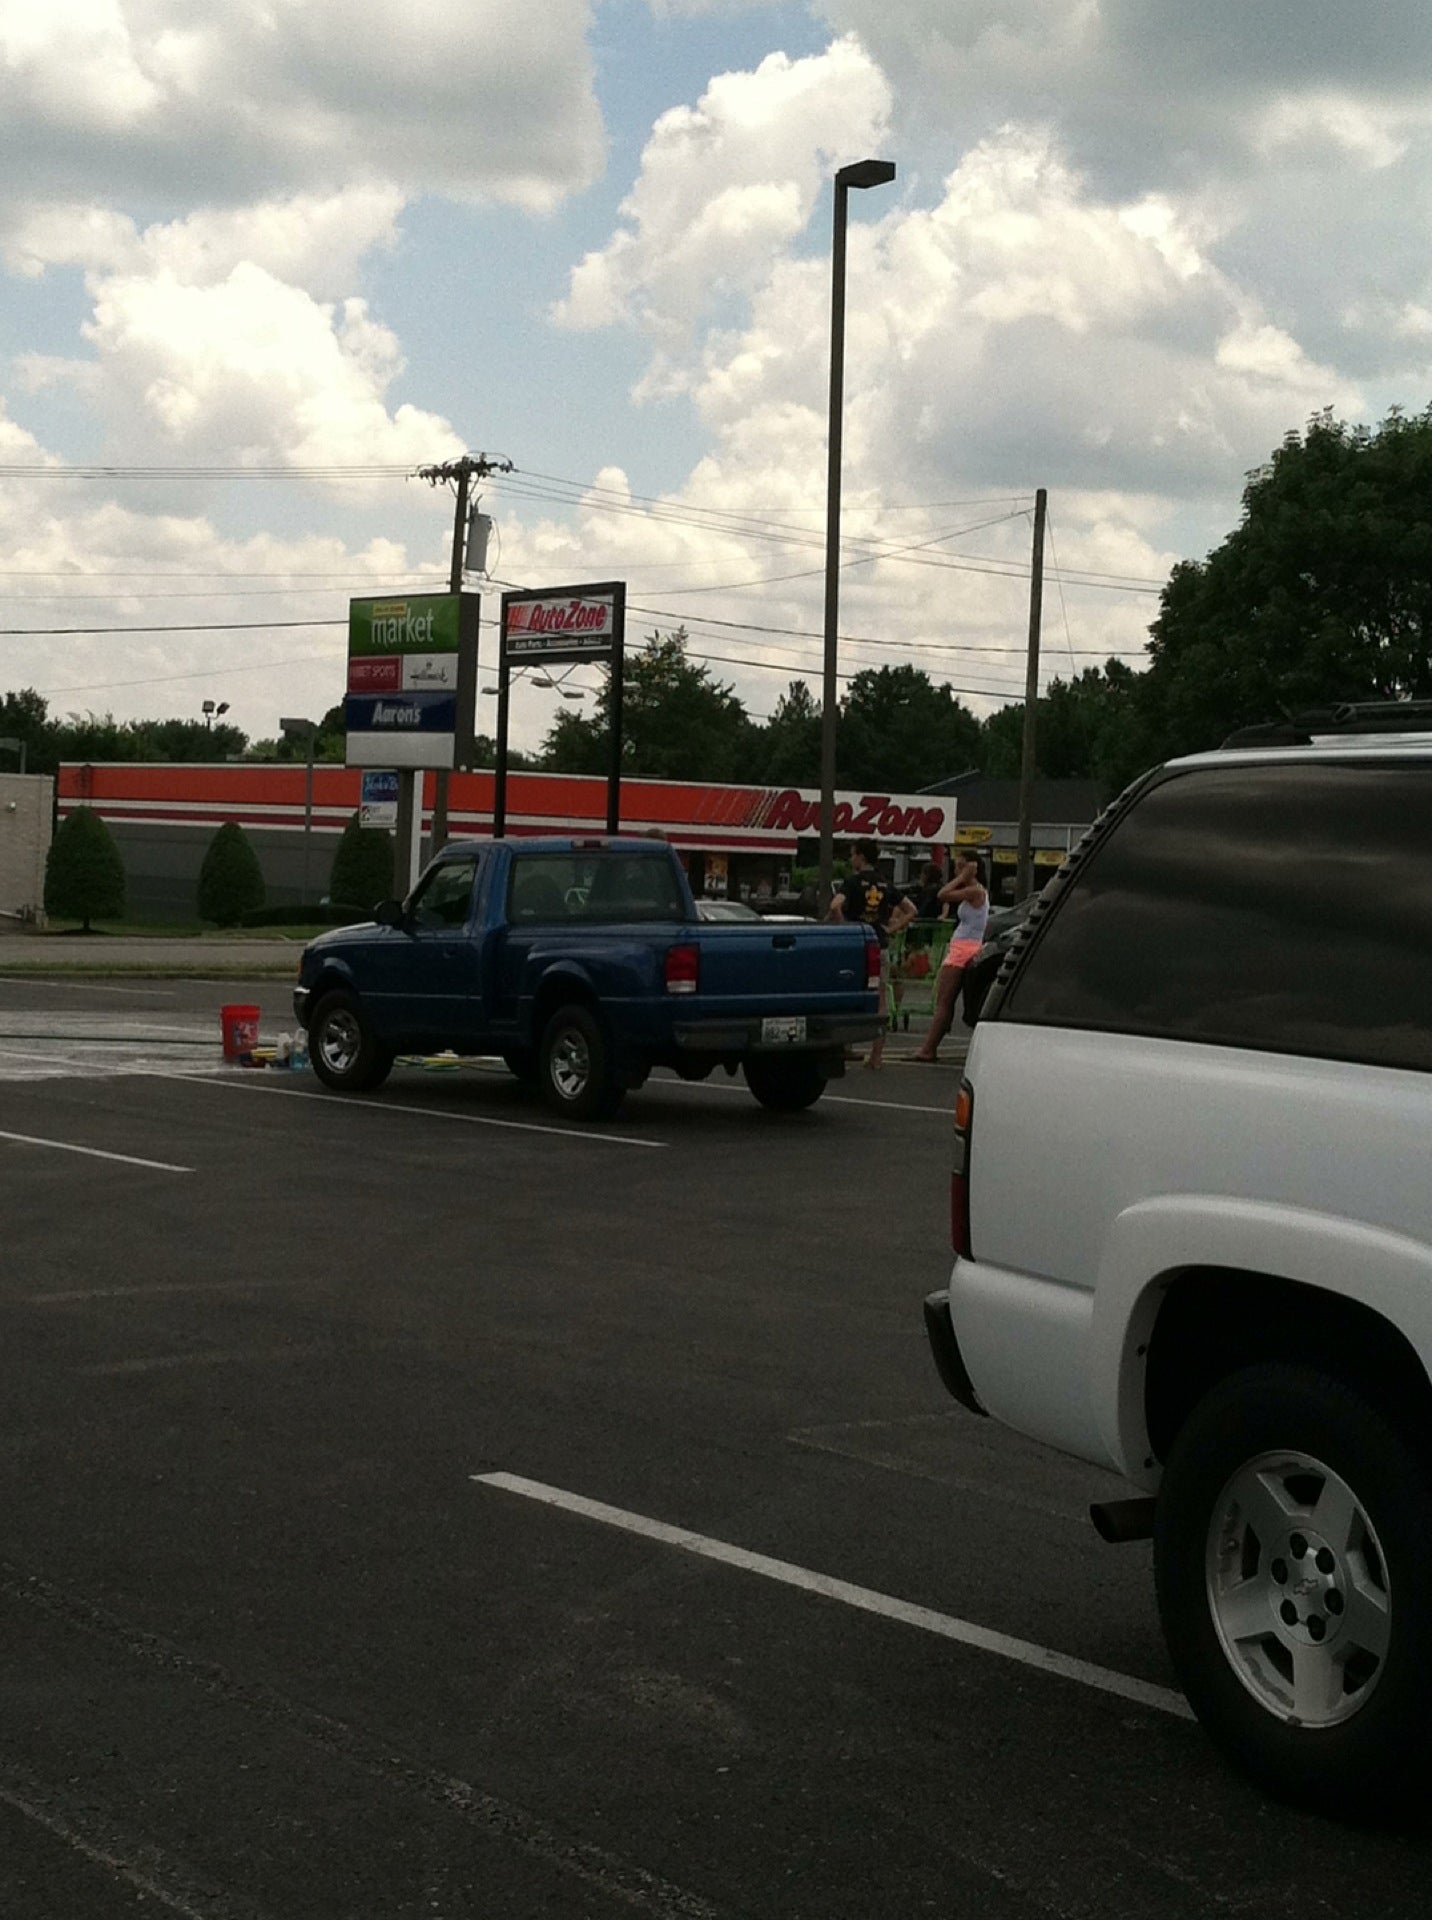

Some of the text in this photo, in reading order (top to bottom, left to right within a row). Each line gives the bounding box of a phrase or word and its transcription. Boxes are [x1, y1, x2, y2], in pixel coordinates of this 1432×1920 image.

[371, 608, 435, 647] market
[528, 601, 607, 631] AutoZone
[762, 790, 944, 838] AuoZone
